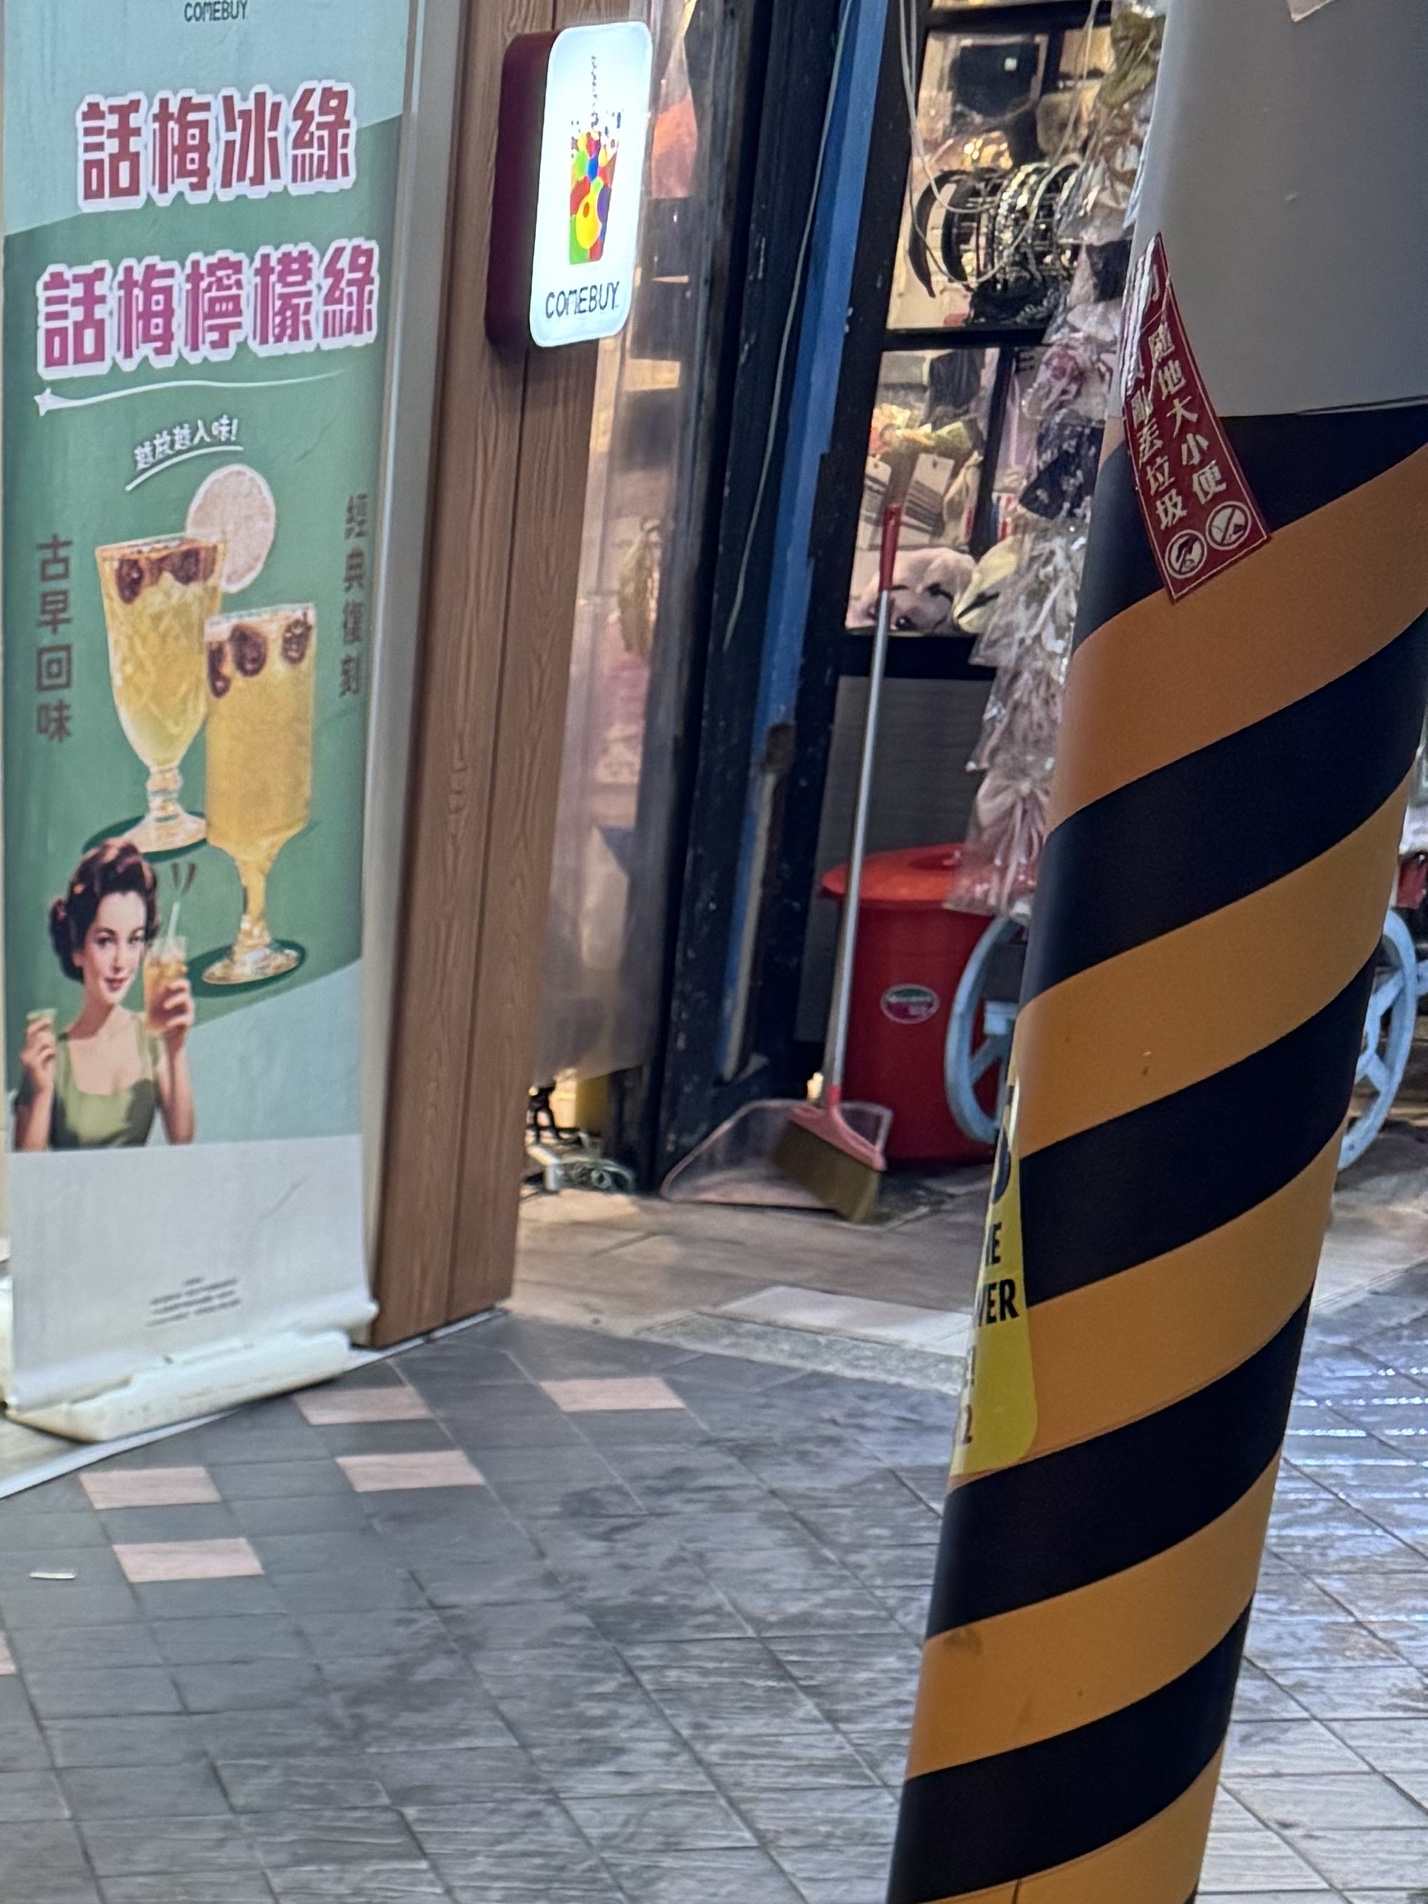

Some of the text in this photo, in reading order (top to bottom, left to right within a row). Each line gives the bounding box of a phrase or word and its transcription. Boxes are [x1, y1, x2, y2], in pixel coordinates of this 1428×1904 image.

[184, 0, 248, 22] COMEBUY
[80, 86, 352, 200] 話梅冰綠
[43, 244, 376, 369] 話梅檸檬綠
[545, 281, 620, 319] COMEBUY
[36, 534, 73, 742] 古早回味
